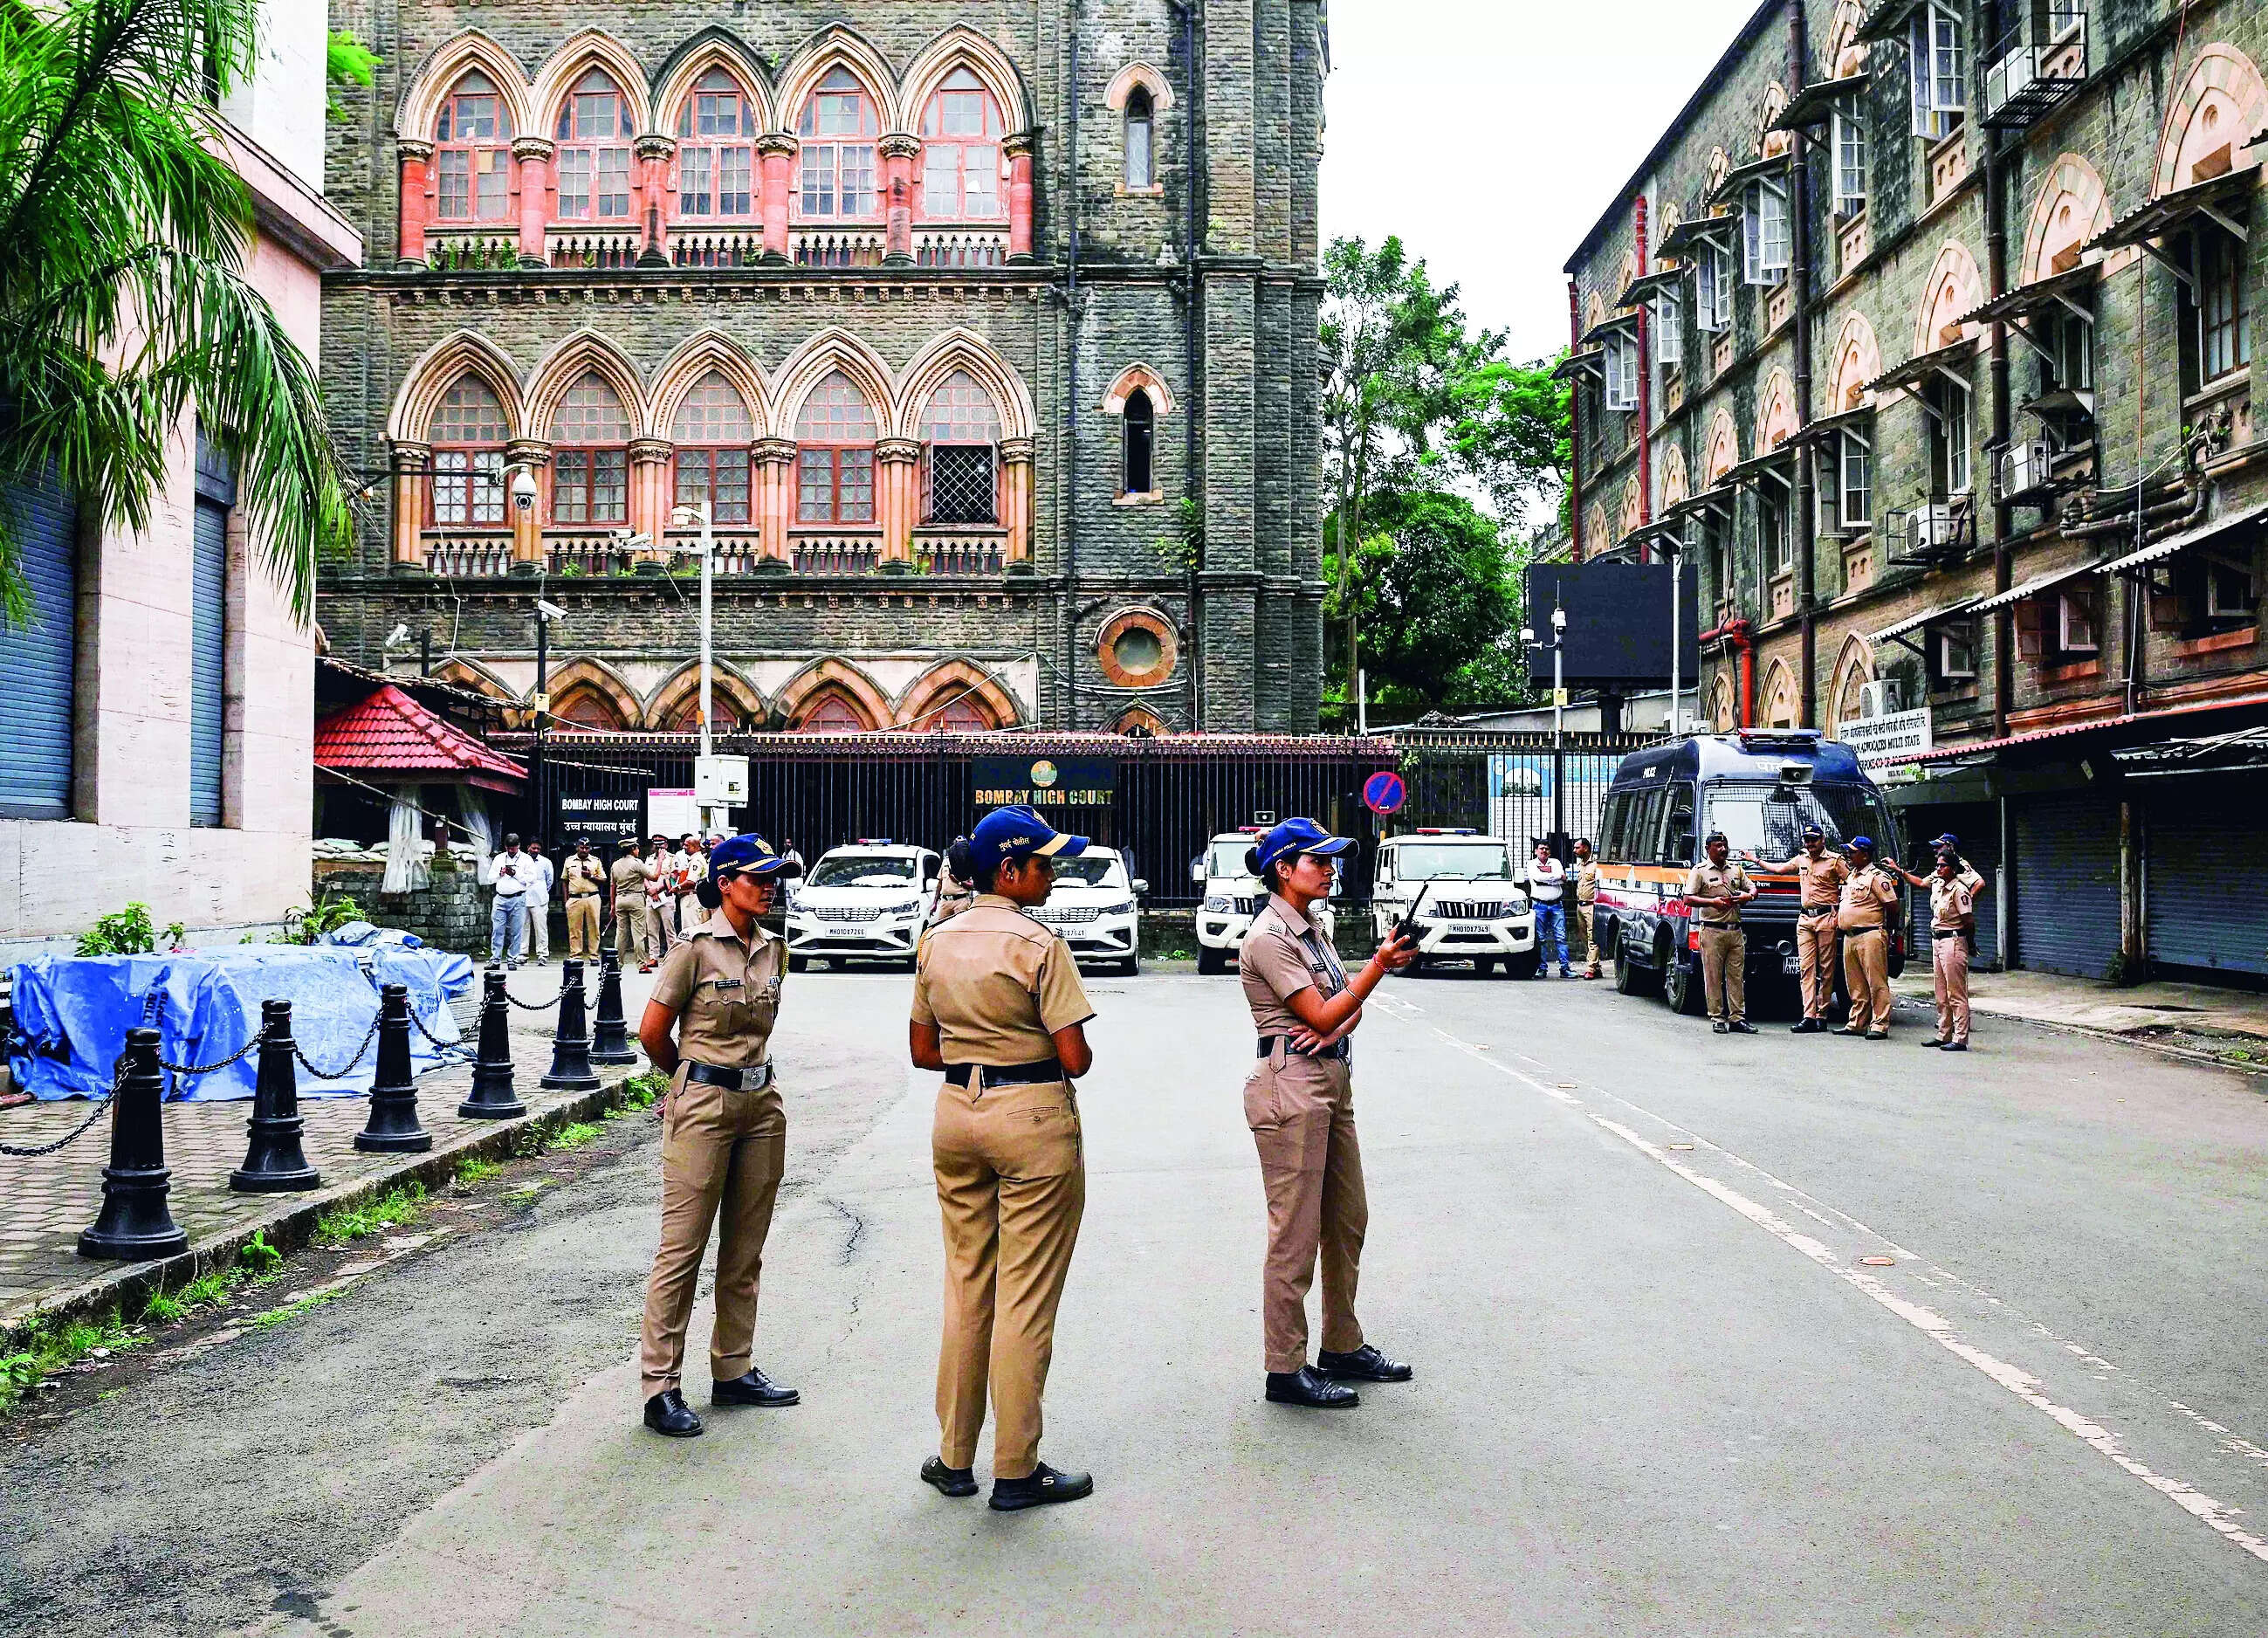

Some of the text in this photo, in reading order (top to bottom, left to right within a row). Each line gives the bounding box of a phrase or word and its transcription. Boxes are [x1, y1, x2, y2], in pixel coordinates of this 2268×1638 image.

[1904, 734, 1921, 747] STATE
[561, 798, 639, 811] BOMBAY HIGH COURT
[975, 789, 1113, 805] BOMBAY HIGH COURT
[564, 819, 636, 836] उच्च न्यायालय मुंबई
[142, 993, 157, 1021] BULL
